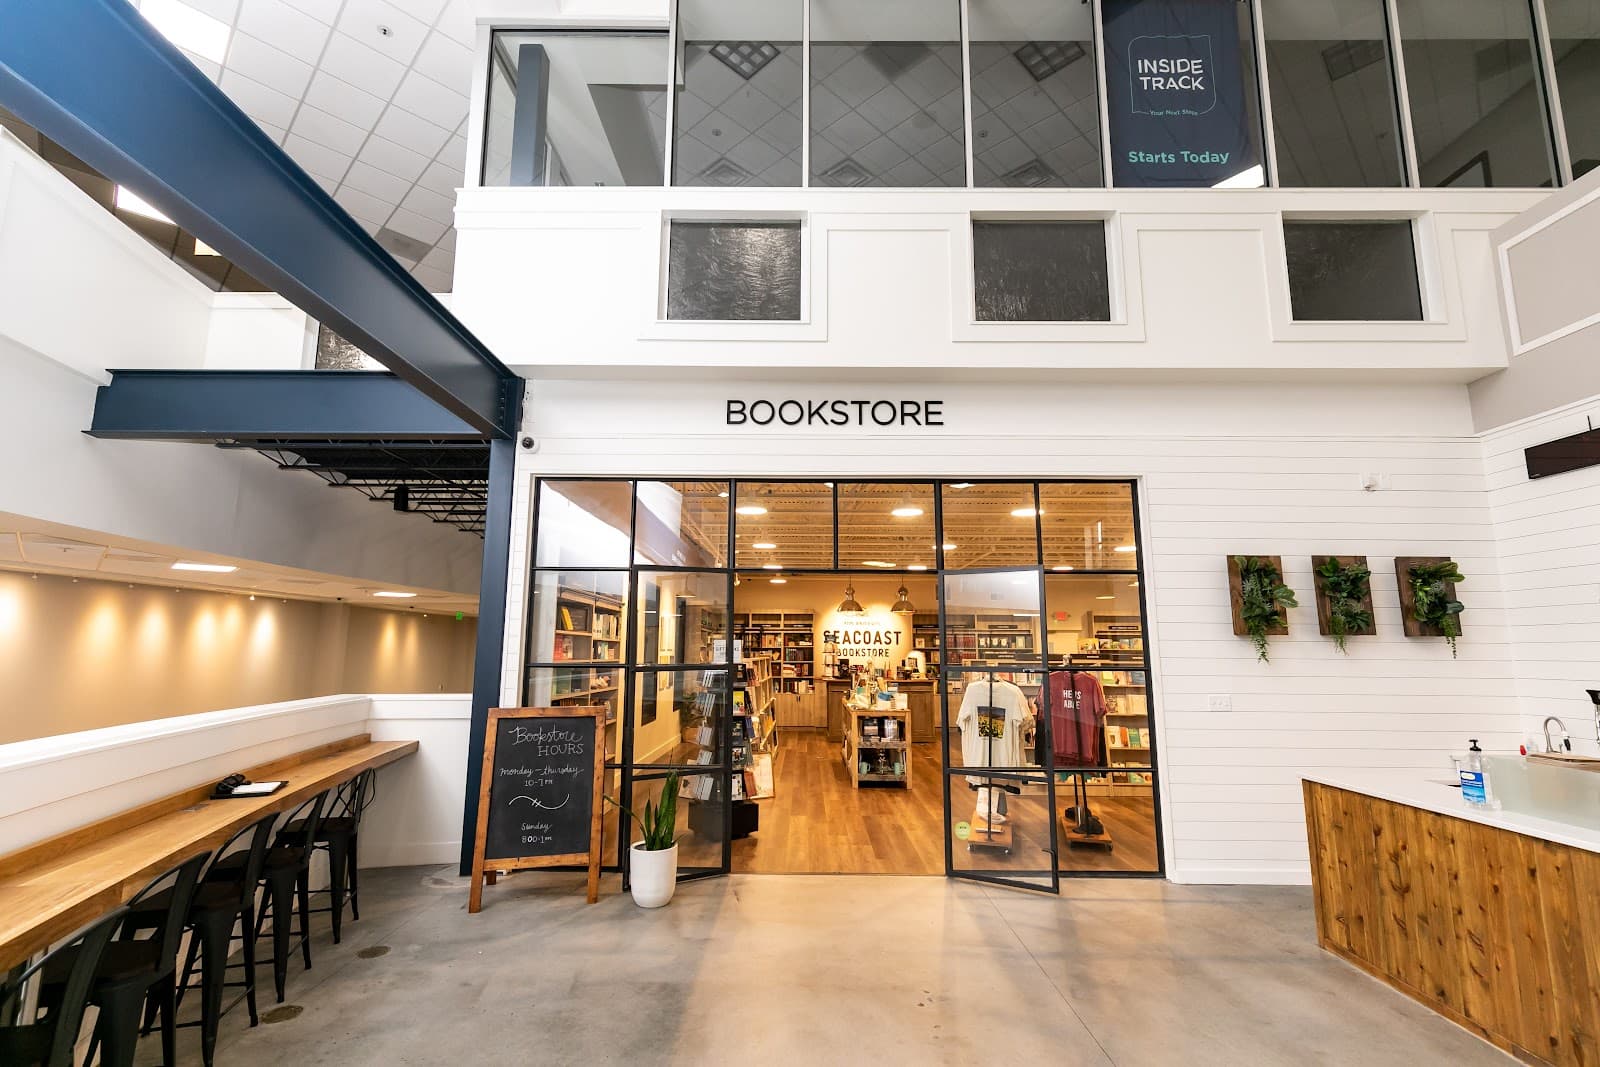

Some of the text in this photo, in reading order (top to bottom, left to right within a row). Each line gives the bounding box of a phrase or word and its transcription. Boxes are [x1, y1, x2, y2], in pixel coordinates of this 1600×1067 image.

[1137, 59, 1204, 74] INSIDE
[1139, 76, 1205, 91] TRACK
[1128, 151, 1230, 165] Starts Today
[726, 400, 944, 426] BOOKSTORE
[823, 630, 902, 646] SEACOAST
[837, 648, 889, 657] BOOKSTORE
[1063, 690, 1073, 699] HE
[508, 724, 583, 745] Bookstore
[537, 743, 584, 757] HOURS
